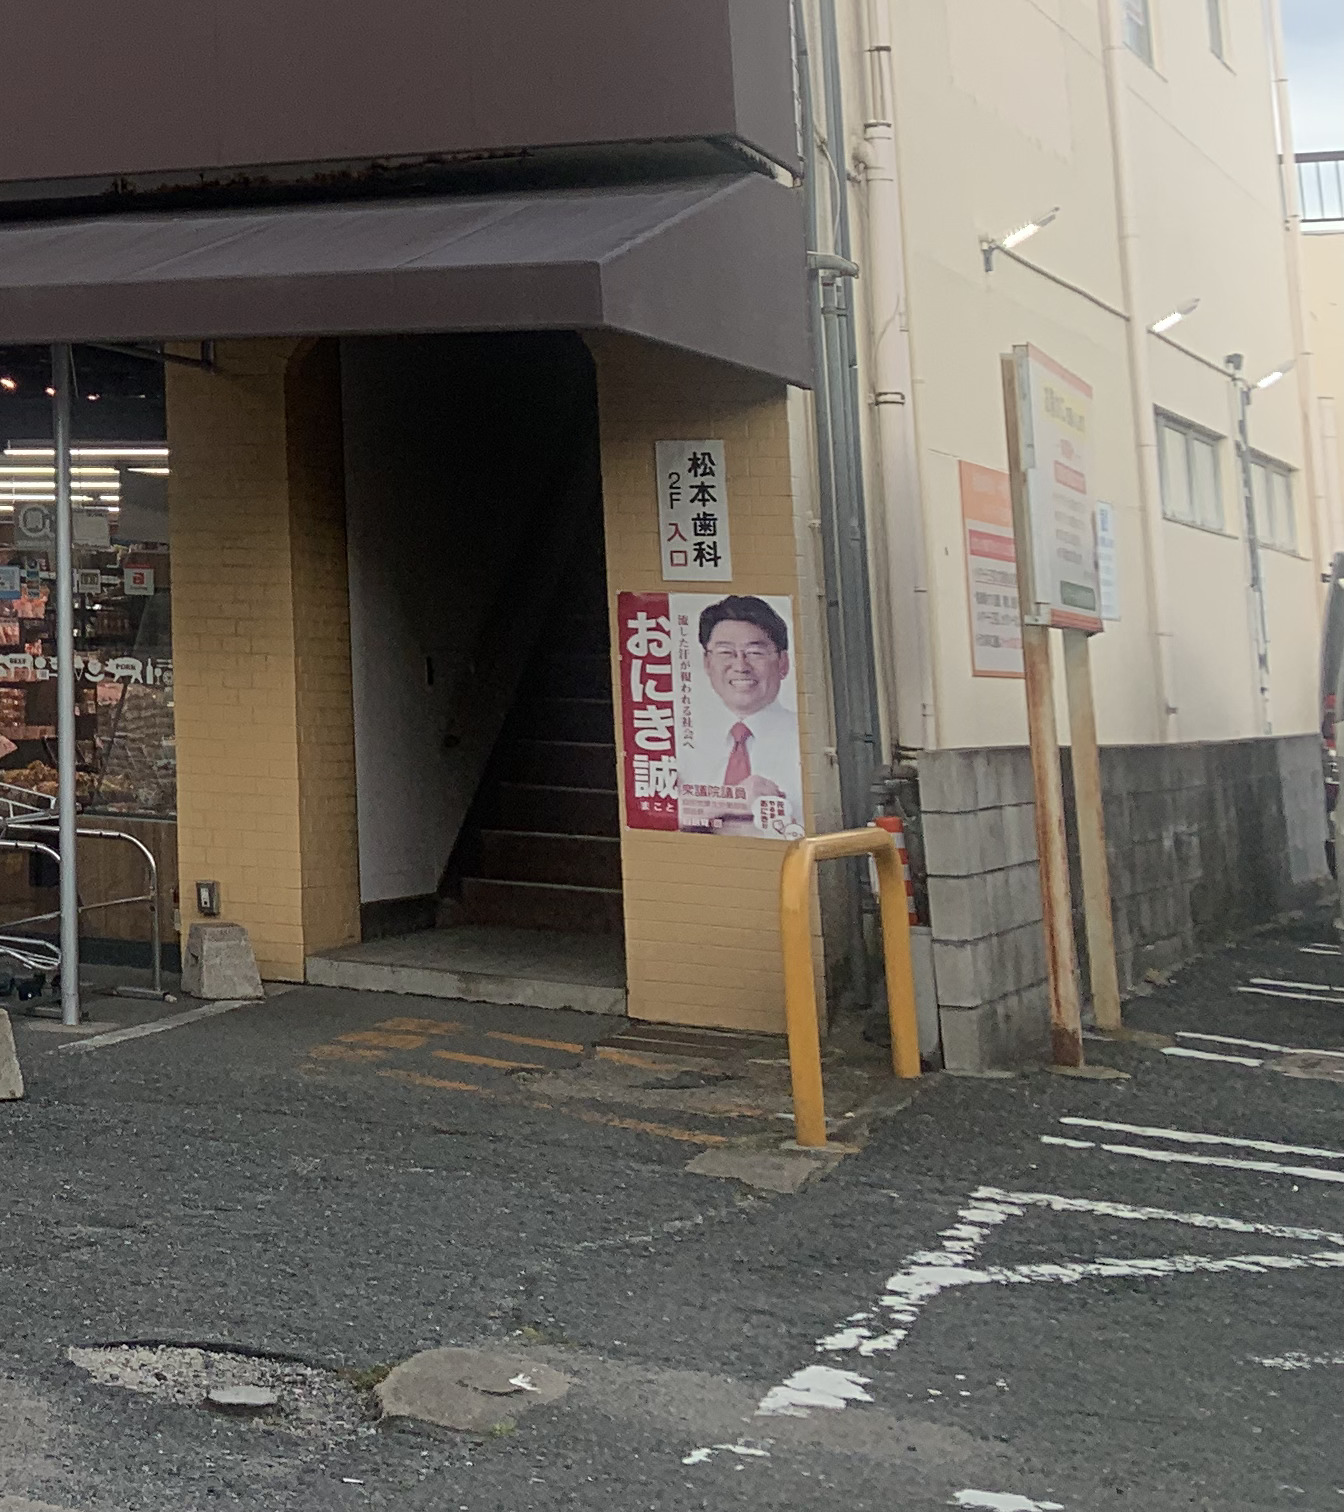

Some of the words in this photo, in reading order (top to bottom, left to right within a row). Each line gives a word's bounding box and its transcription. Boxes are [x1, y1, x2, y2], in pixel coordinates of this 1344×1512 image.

[667, 521, 689, 568] 入口
[687, 451, 722, 569] 松本歯科
[626, 611, 679, 800] おにき誠
